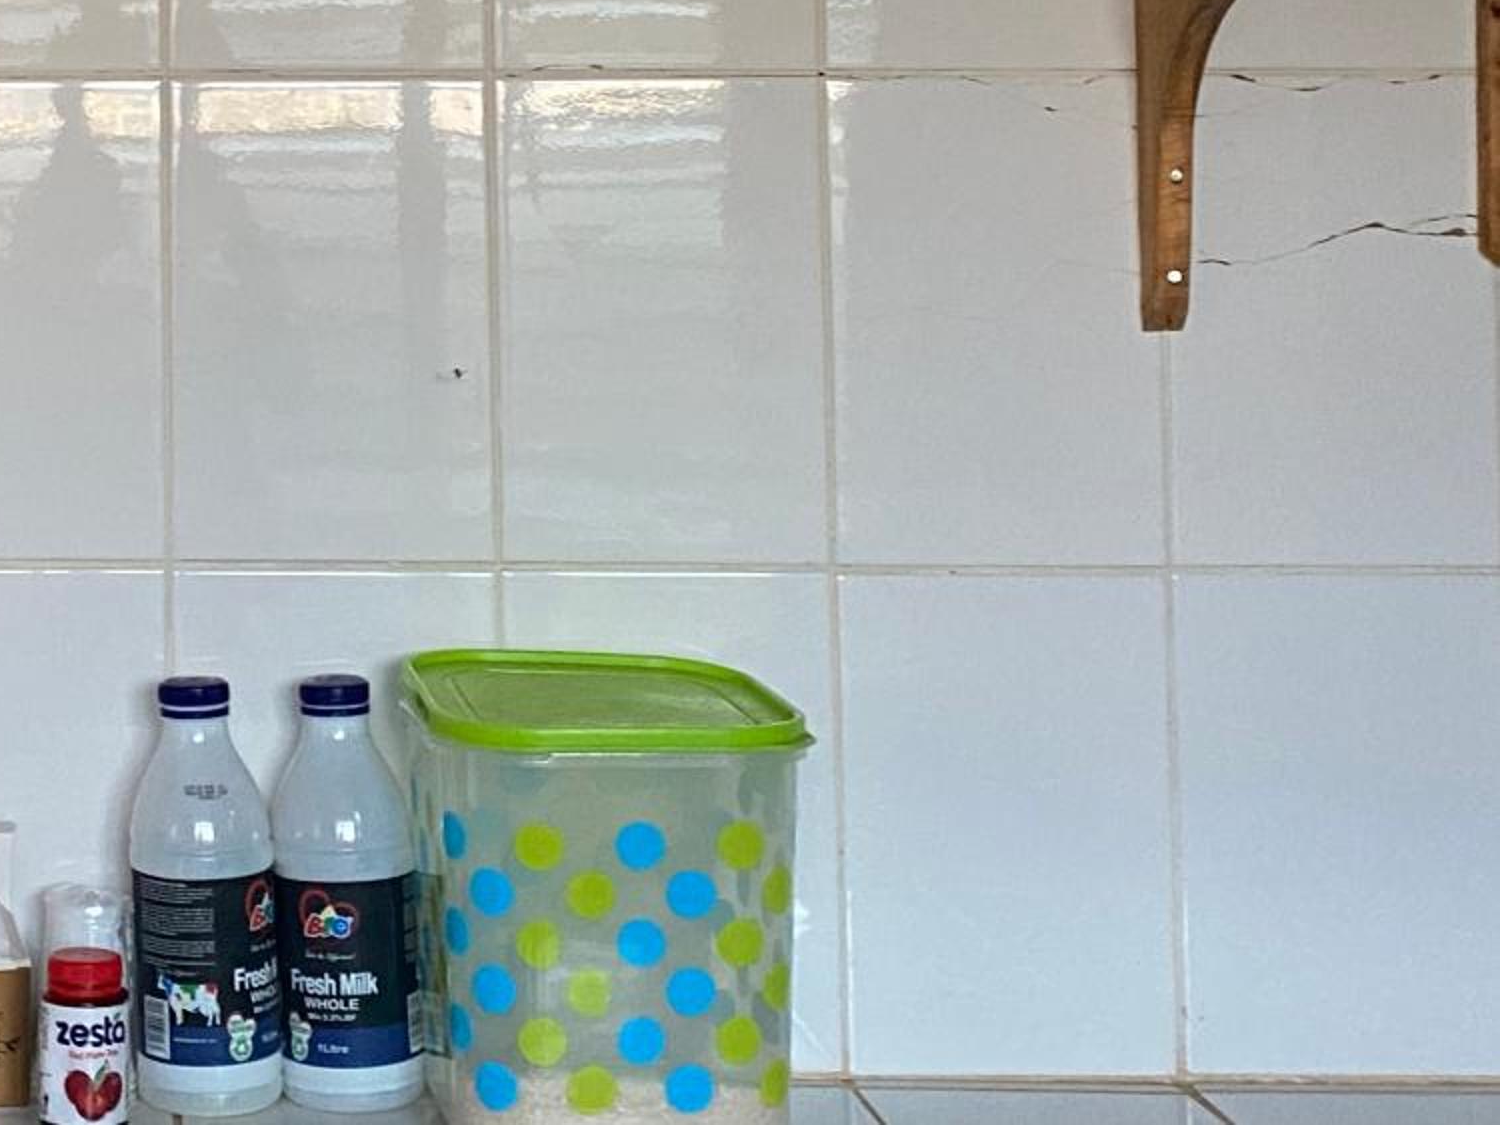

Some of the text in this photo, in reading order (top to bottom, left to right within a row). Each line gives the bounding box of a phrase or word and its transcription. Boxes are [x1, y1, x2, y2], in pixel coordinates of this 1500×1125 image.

[291, 968, 337, 996] Fresh
[340, 972, 379, 996] Milk
[304, 997, 360, 1011] WHOLE
